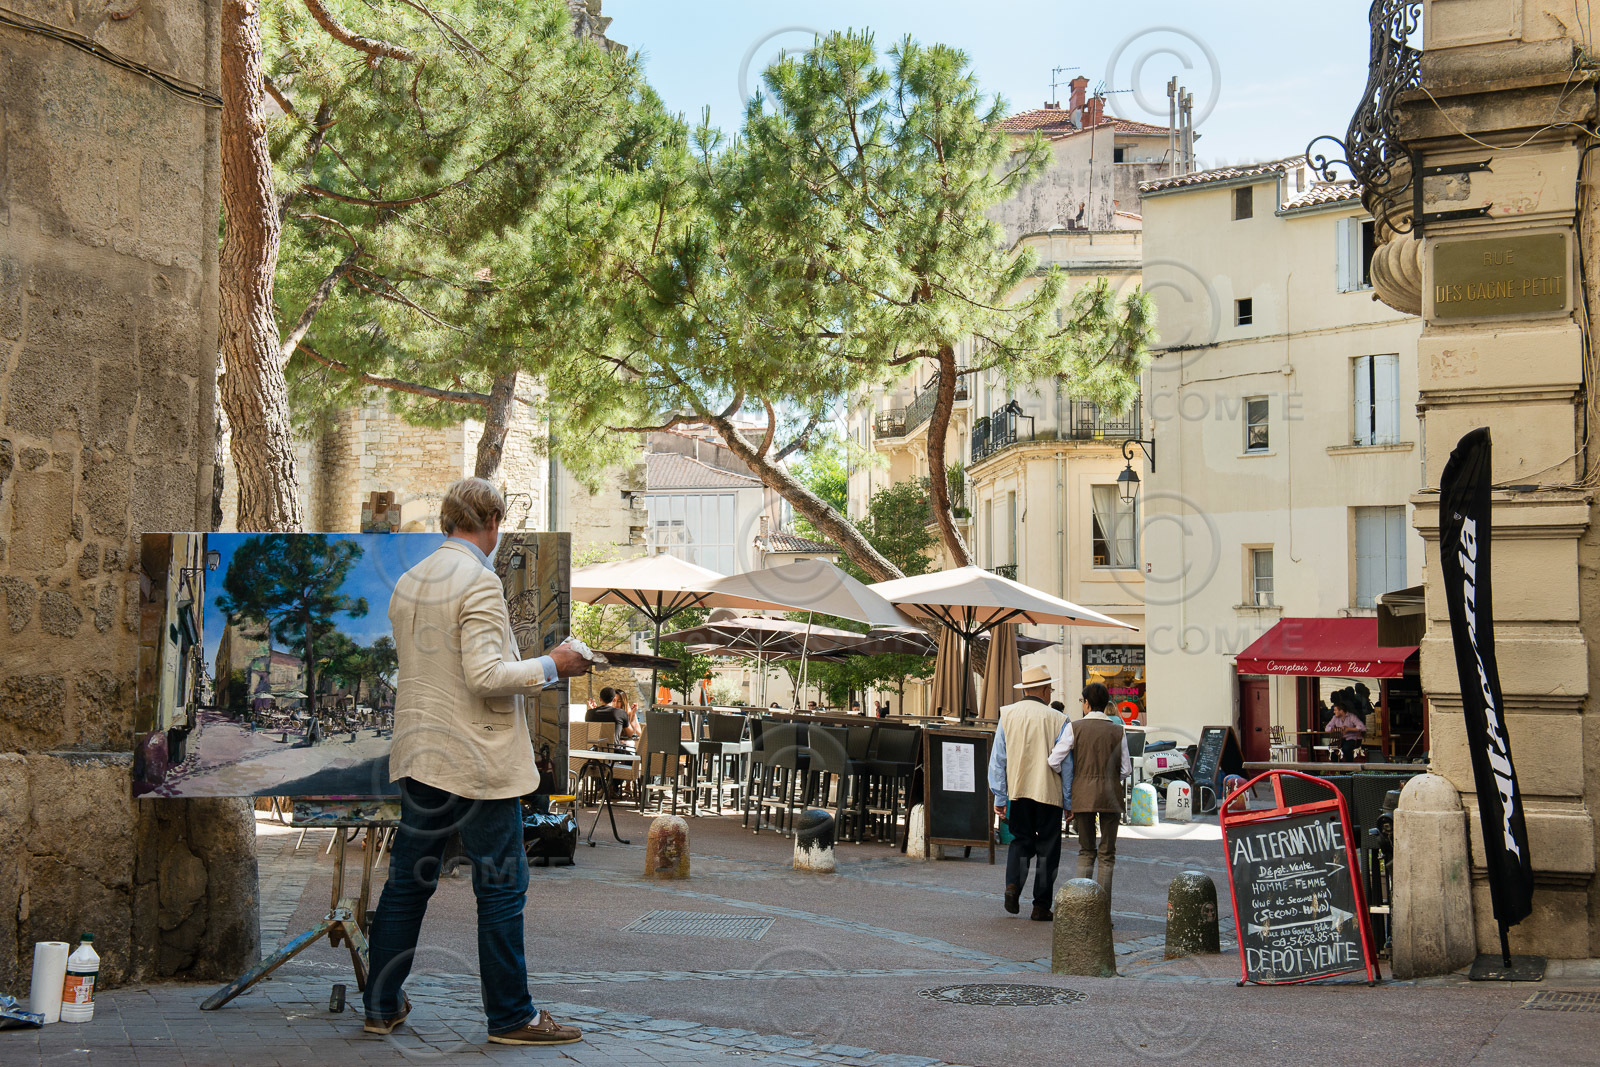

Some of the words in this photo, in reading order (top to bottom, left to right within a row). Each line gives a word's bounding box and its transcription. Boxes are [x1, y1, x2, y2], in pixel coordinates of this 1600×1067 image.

[1483, 250, 1514, 266] RUE
[1436, 284, 1462, 303] DES
[1467, 276, 1563, 301] GAGNE-PETIT
[1087, 649, 1144, 664] HOME
[1266, 660, 1308, 675] Comptoir
[1314, 661, 1342, 673] Saint
[1347, 661, 1371, 673] Paul
[1232, 820, 1347, 866] ALTERNATIVE
